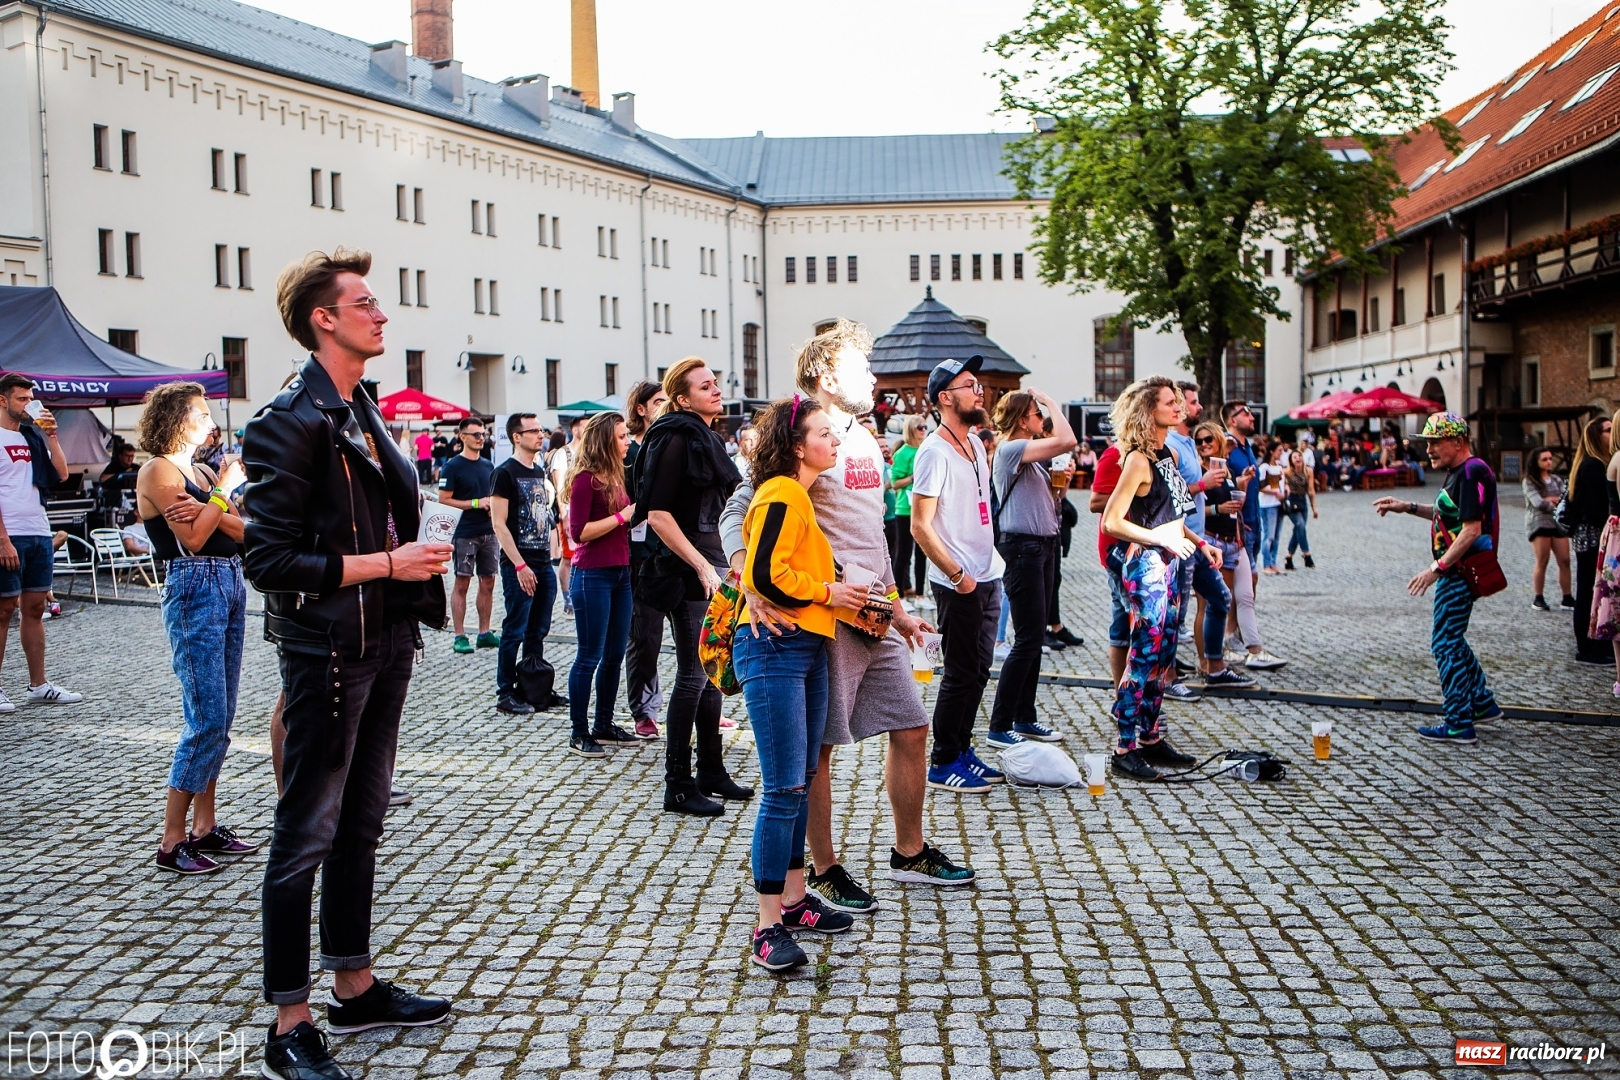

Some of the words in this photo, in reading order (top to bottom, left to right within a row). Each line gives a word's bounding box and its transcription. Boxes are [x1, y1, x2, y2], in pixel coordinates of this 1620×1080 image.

[31, 380, 110, 393] AGENCY
[845, 456, 875, 470] SUPER
[844, 469, 881, 490] MARIO
[799, 909, 821, 928] N
[759, 940, 774, 961] N
